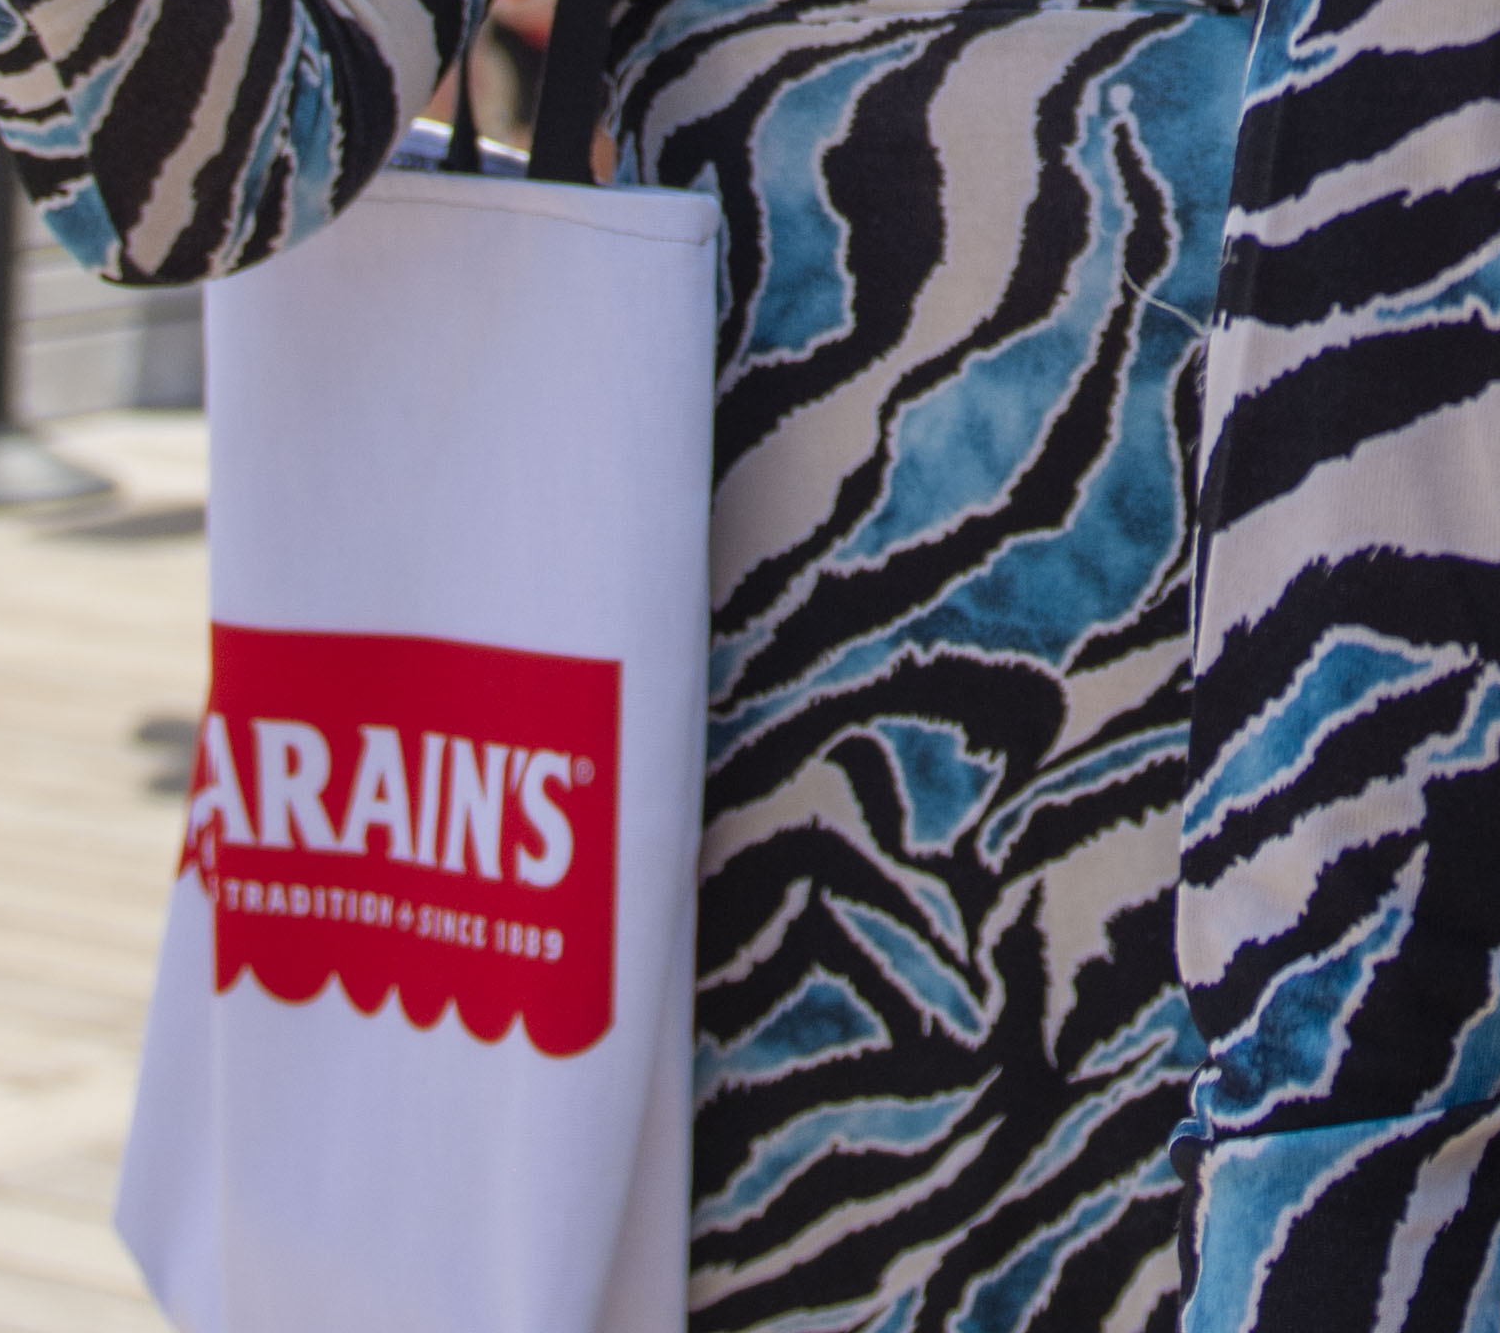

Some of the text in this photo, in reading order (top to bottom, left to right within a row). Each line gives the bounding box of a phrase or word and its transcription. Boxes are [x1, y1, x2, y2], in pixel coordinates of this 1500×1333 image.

[225, 878, 393, 928] TRADITION
[417, 903, 487, 949] SINCE
[494, 919, 564, 963] 1889
